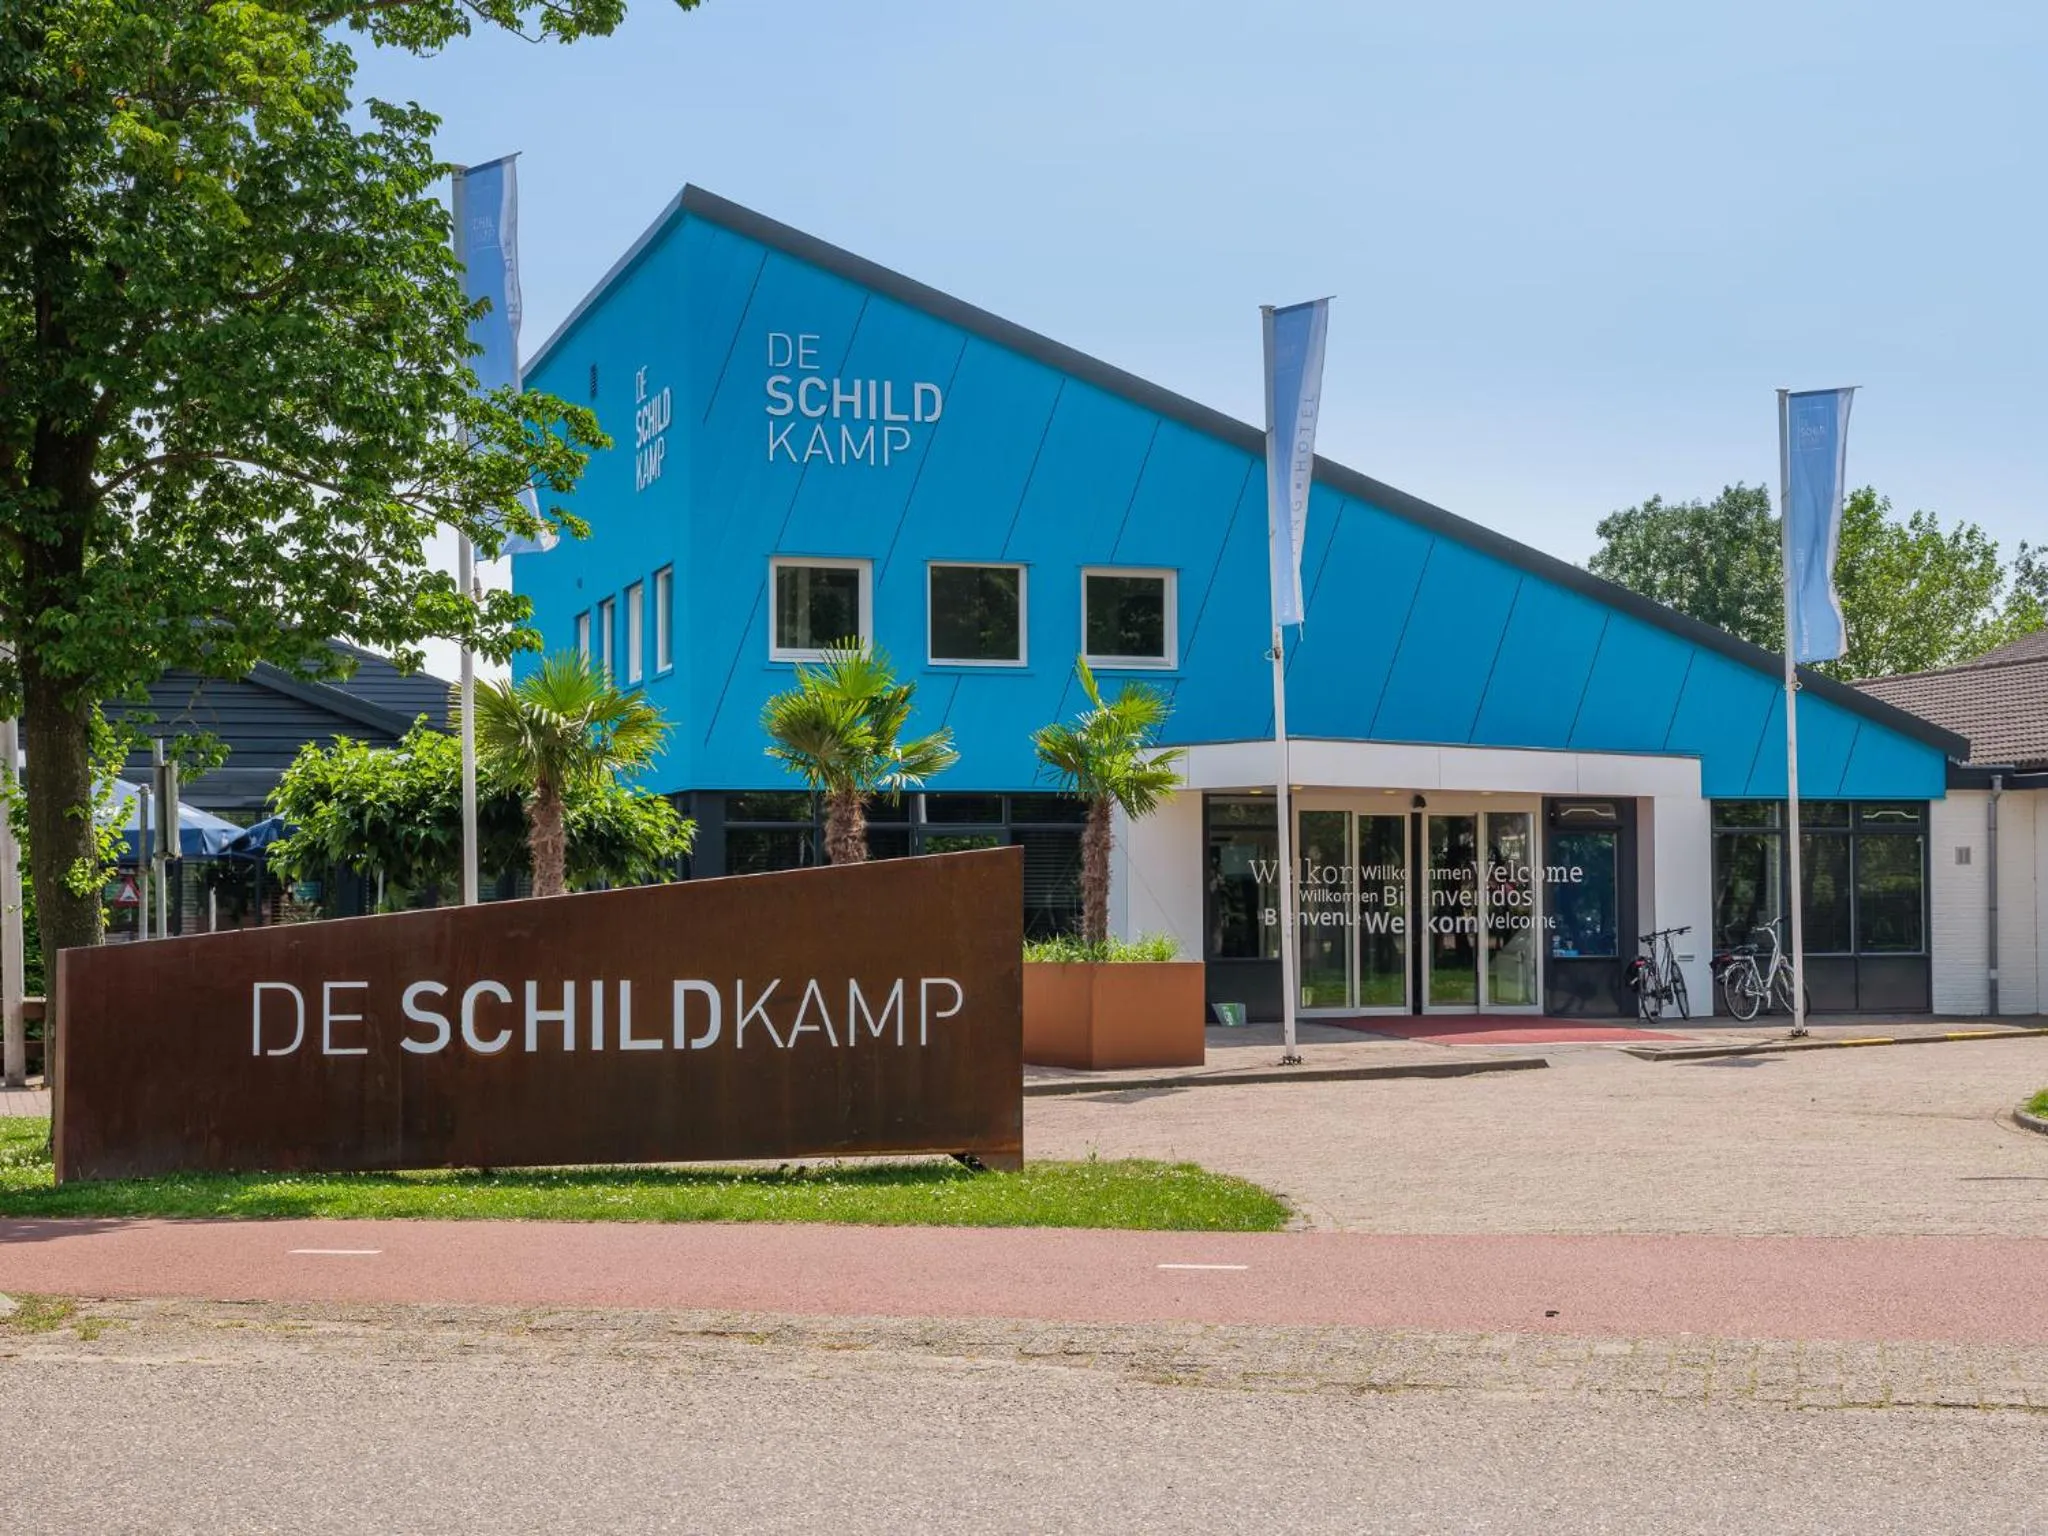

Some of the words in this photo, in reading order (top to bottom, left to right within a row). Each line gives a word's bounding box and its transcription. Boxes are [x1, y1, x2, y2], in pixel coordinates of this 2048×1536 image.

[768, 332, 820, 369] DE
[636, 365, 647, 404] DE
[765, 375, 943, 422] SCHILD
[636, 386, 671, 448] SCHILD
[636, 436, 665, 492] KAMP
[767, 420, 911, 466] KAMP
[1365, 911, 1478, 935] Wekom
[251, 981, 370, 1057] DE
